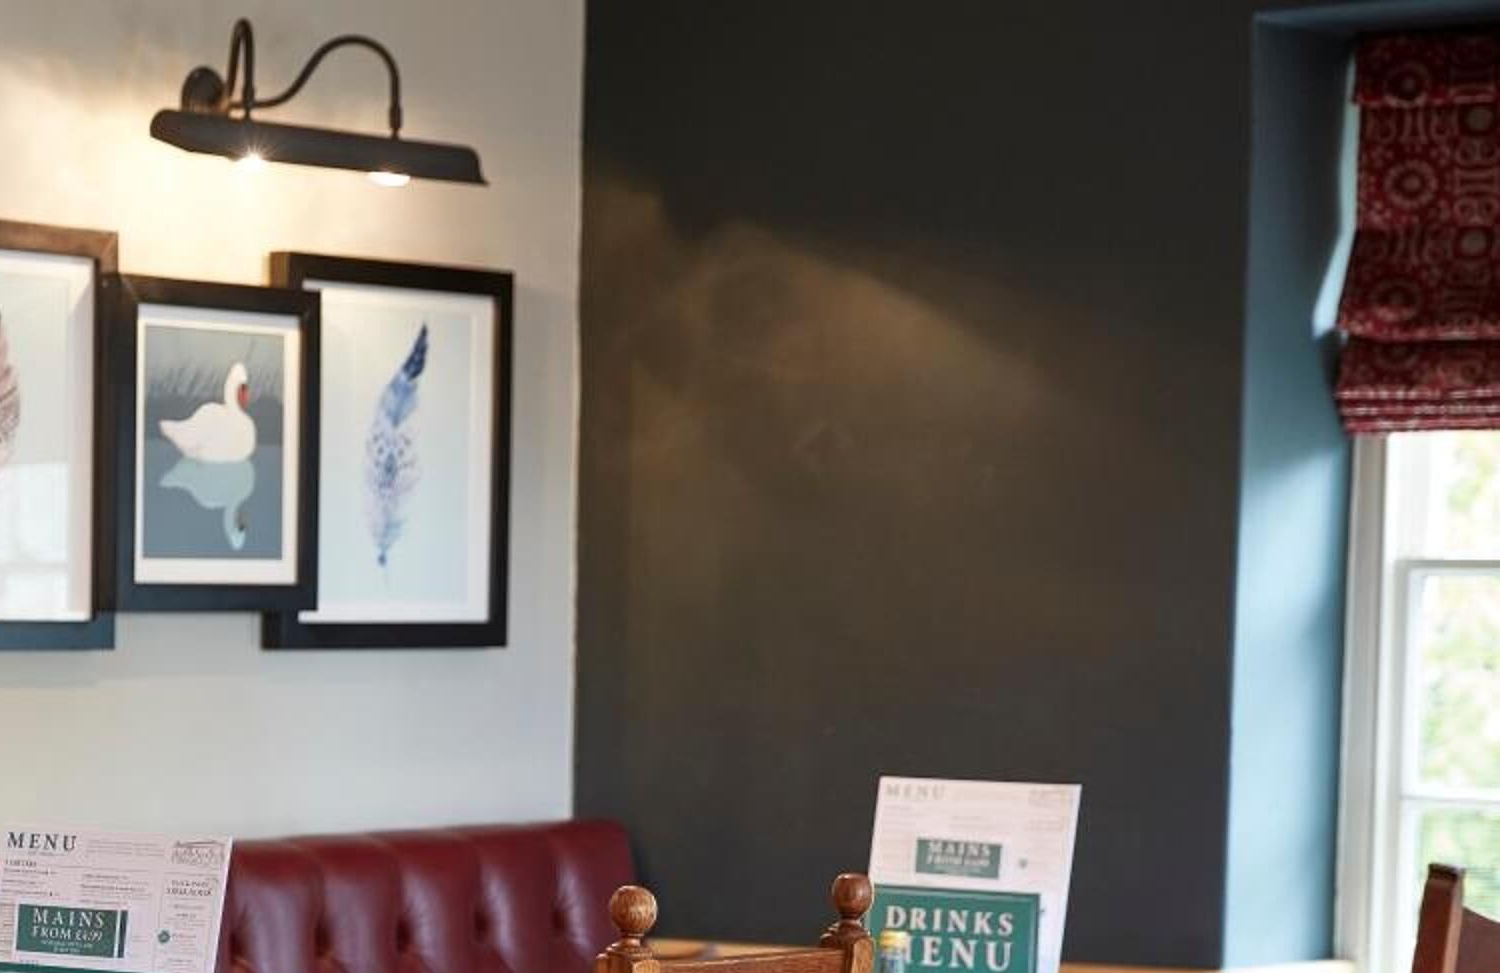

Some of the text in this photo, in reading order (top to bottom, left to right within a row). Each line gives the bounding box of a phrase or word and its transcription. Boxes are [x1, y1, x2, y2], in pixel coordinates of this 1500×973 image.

[7, 831, 77, 852] MENU
[928, 841, 990, 857] MAINS
[32, 908, 105, 929] MAINS
[885, 905, 1013, 936] DRINKS
[32, 926, 71, 940] FROM
[905, 935, 1013, 973] ENU
